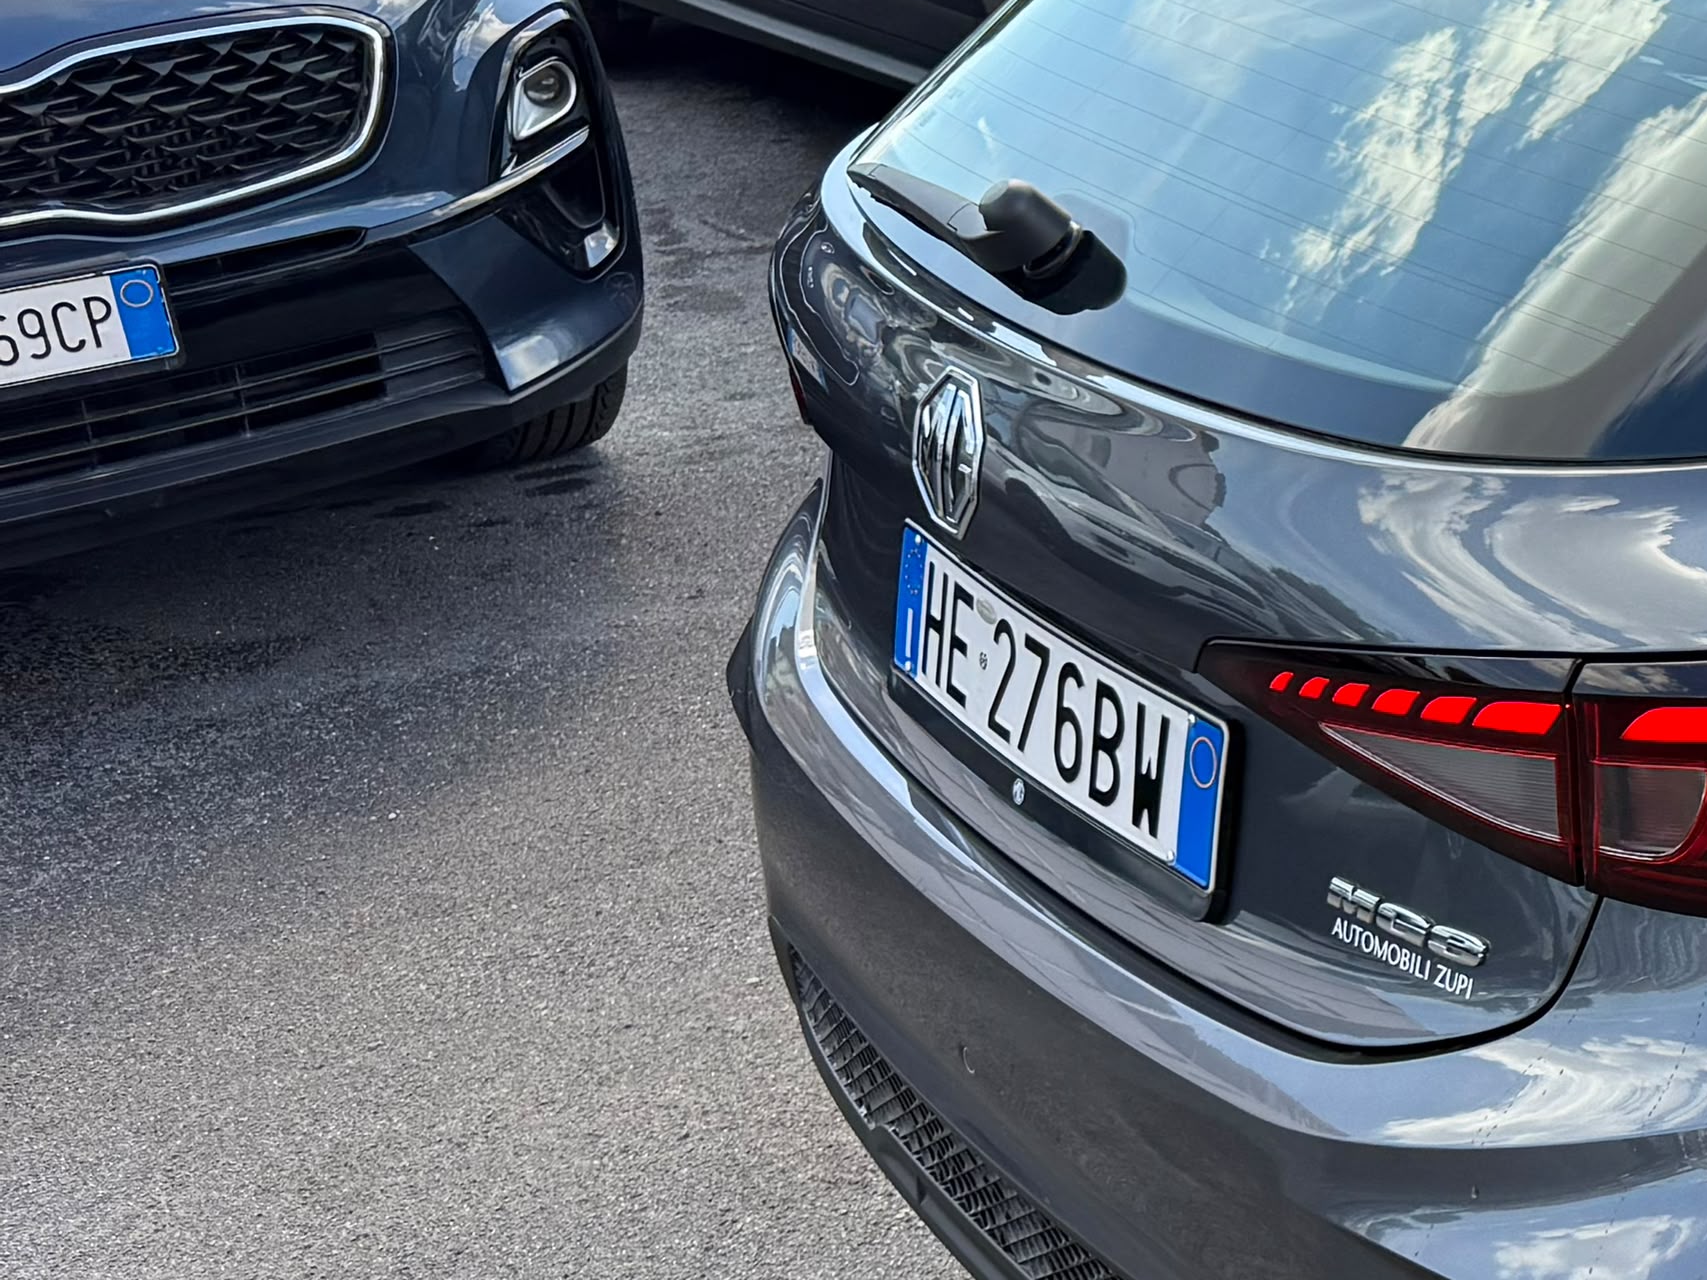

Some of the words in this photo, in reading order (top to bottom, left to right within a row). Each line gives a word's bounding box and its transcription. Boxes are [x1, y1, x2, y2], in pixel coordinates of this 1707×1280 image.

[0, 295, 112, 366] 69CP
[921, 560, 975, 710] HE
[987, 618, 1171, 840] 276BW
[1331, 916, 1431, 981] AUTOMOBILI
[1433, 963, 1474, 1000] ZUPI
